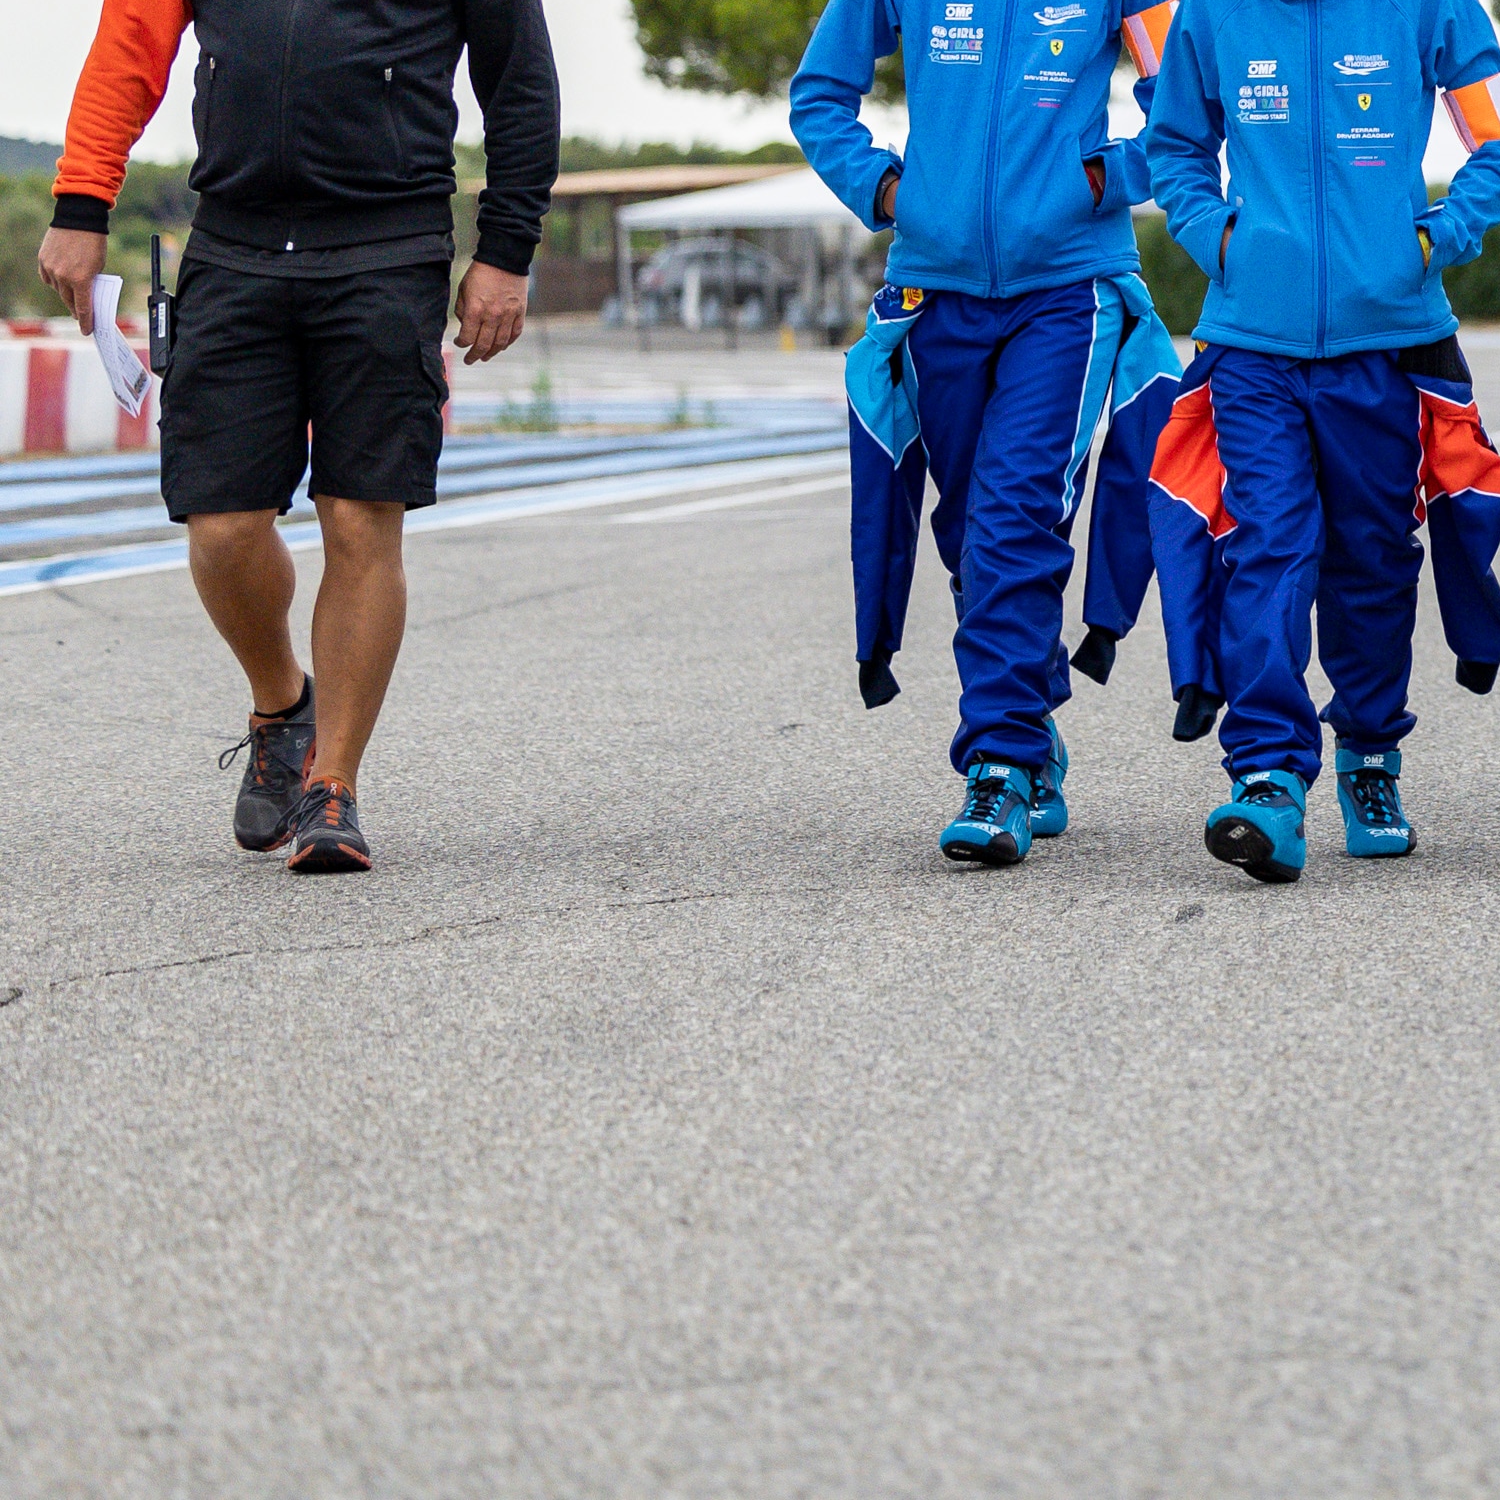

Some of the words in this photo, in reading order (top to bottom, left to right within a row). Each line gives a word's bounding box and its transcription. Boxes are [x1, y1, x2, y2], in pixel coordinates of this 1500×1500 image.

[945, 7, 973, 17] OMP
[948, 28, 984, 39] GIRLS
[930, 37, 948, 50] ON
[1248, 64, 1277, 74] OMP
[1254, 85, 1289, 97] GIRLS
[1238, 99, 1256, 109] ON
[1364, 756, 1384, 764] OMP
